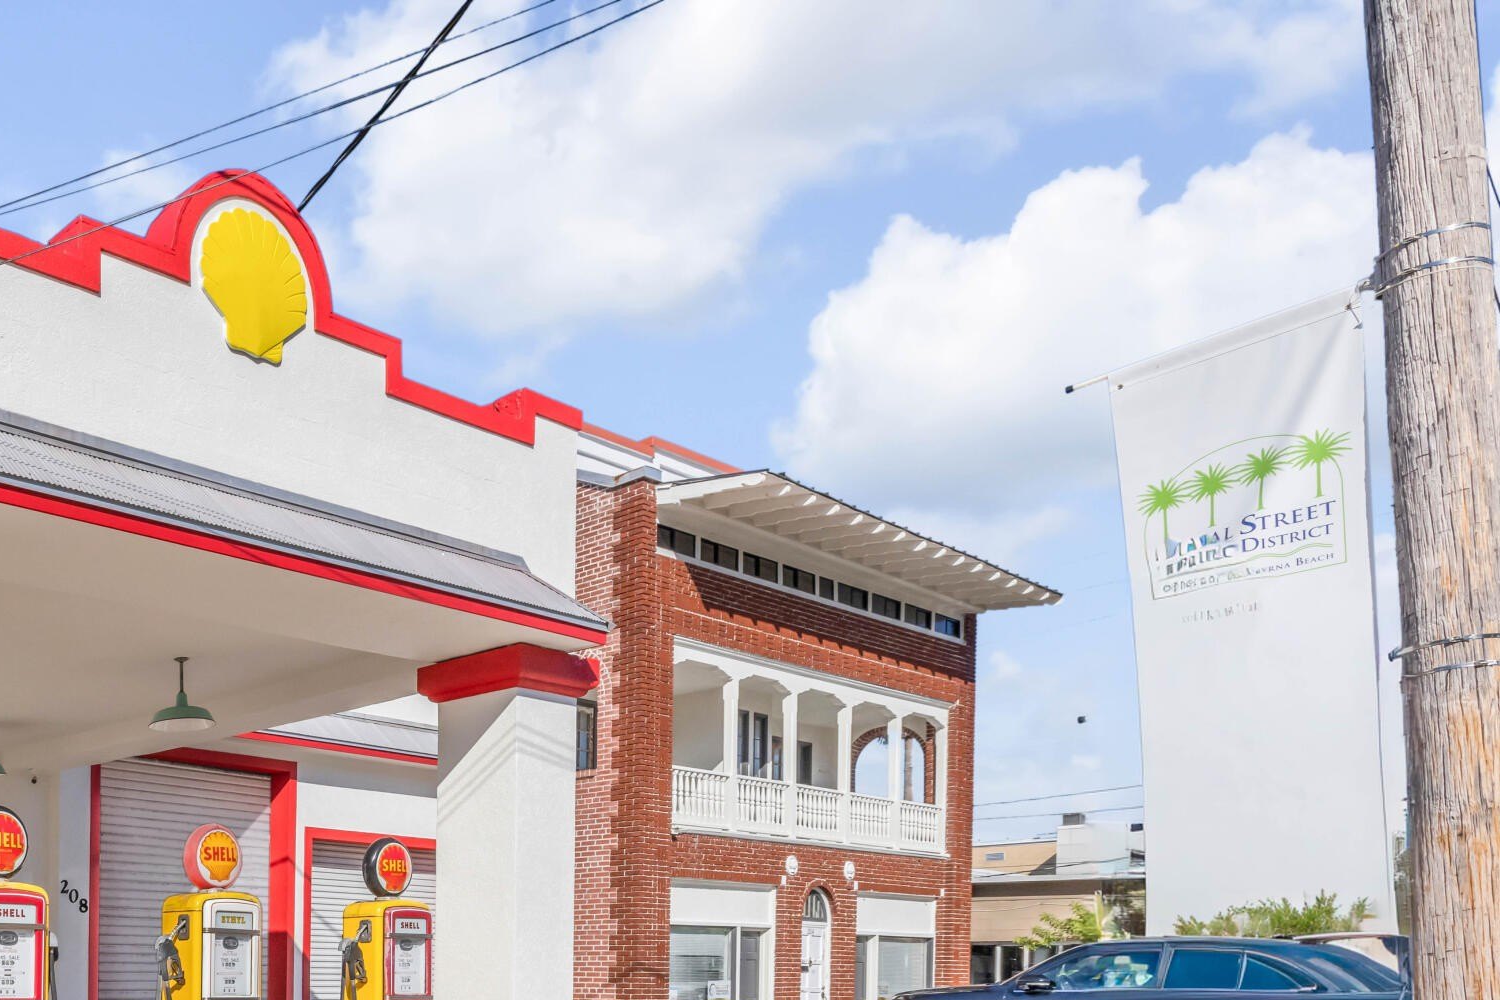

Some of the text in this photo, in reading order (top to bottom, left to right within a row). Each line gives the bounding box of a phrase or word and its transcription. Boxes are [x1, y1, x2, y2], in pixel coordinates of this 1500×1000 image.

[1240, 501, 1336, 535] STREET
[1241, 523, 1334, 553] DISTRICT
[1296, 553, 1334, 567] BEACH
[203, 846, 237, 862] SHELL
[60, 879, 88, 913] 208
[400, 921, 420, 930] SHELL
